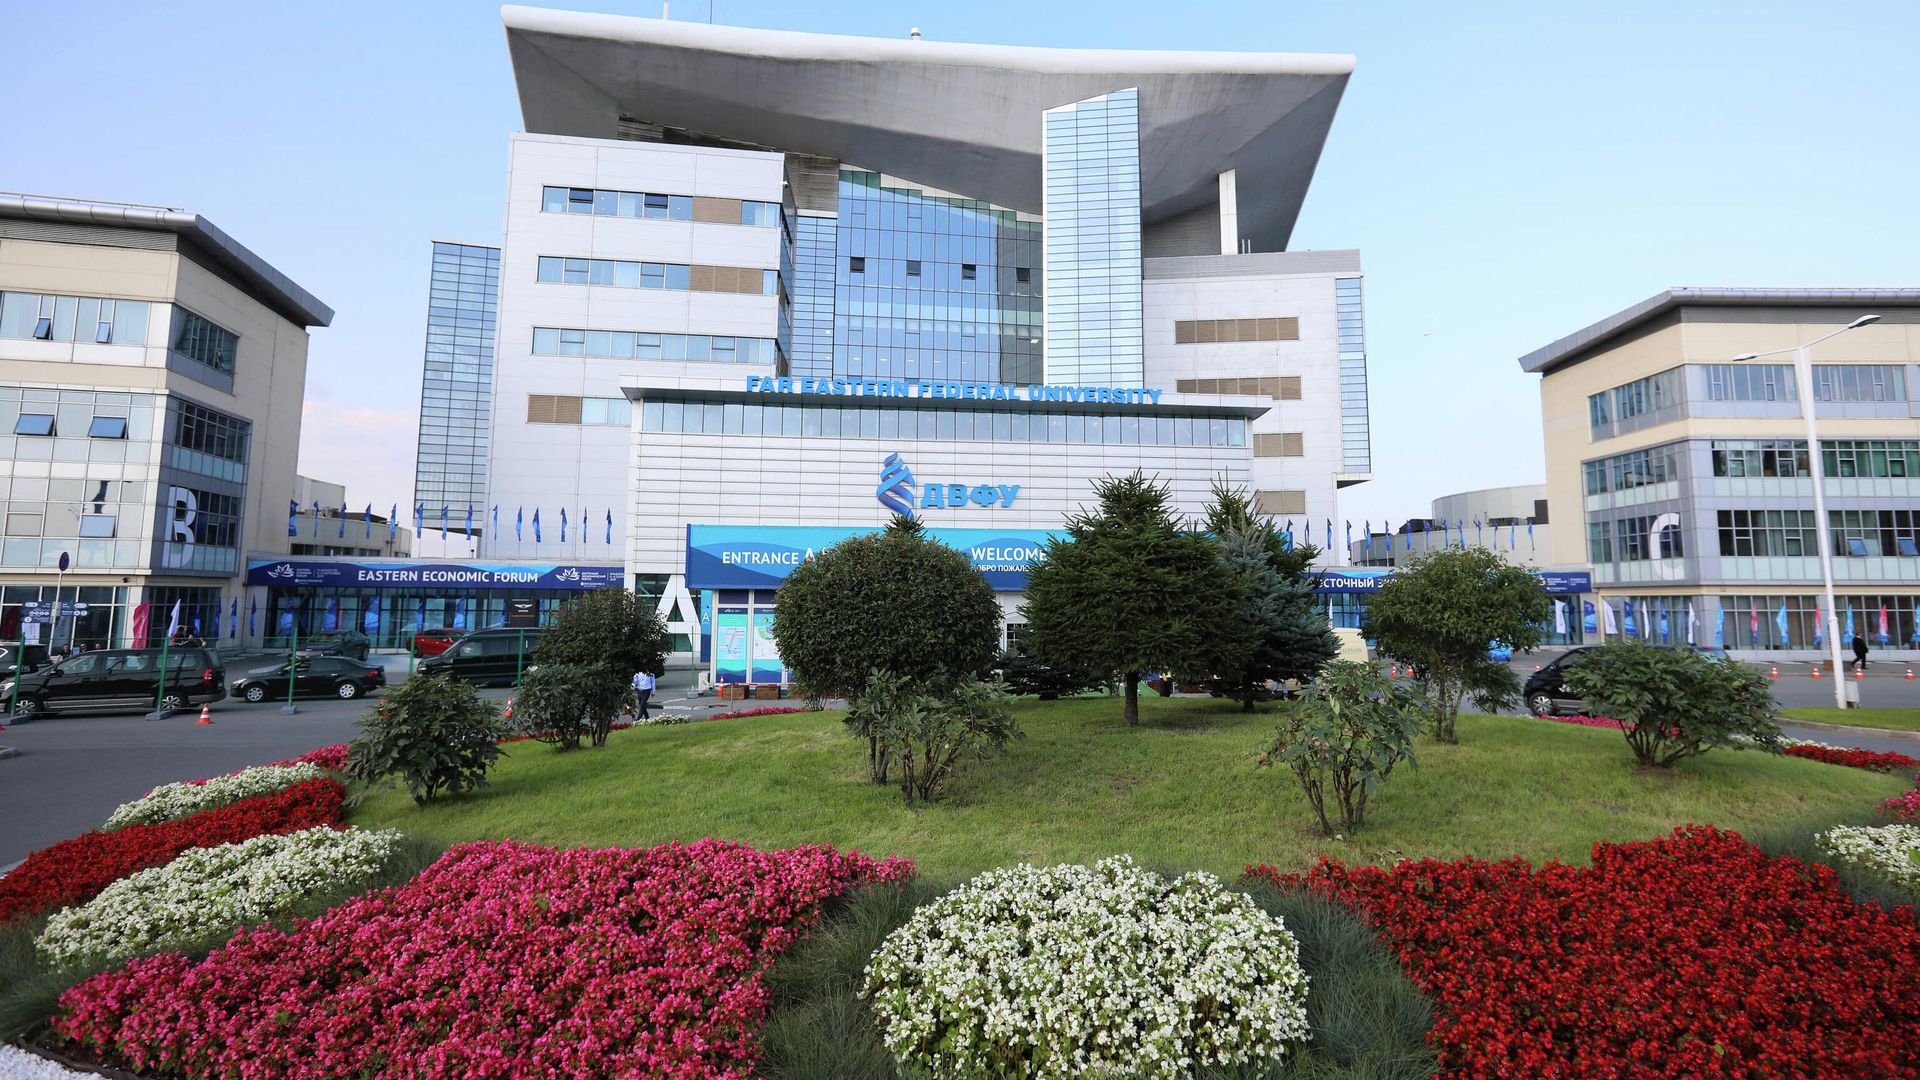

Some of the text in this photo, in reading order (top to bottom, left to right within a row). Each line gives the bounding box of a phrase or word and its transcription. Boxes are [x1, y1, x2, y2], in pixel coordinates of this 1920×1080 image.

[746, 376, 1161, 405] FAR EASTERN FEDERAL UNIVERSITY
[920, 483, 1020, 509] ДВФУ
[162, 486, 197, 568] B
[722, 551, 799, 565] ENTRANCE
[971, 547, 1048, 561] WELCOME
[1651, 512, 1685, 580] C
[358, 570, 538, 583] EASTERN ECONOMIC FORUM
[644, 574, 702, 652] A
